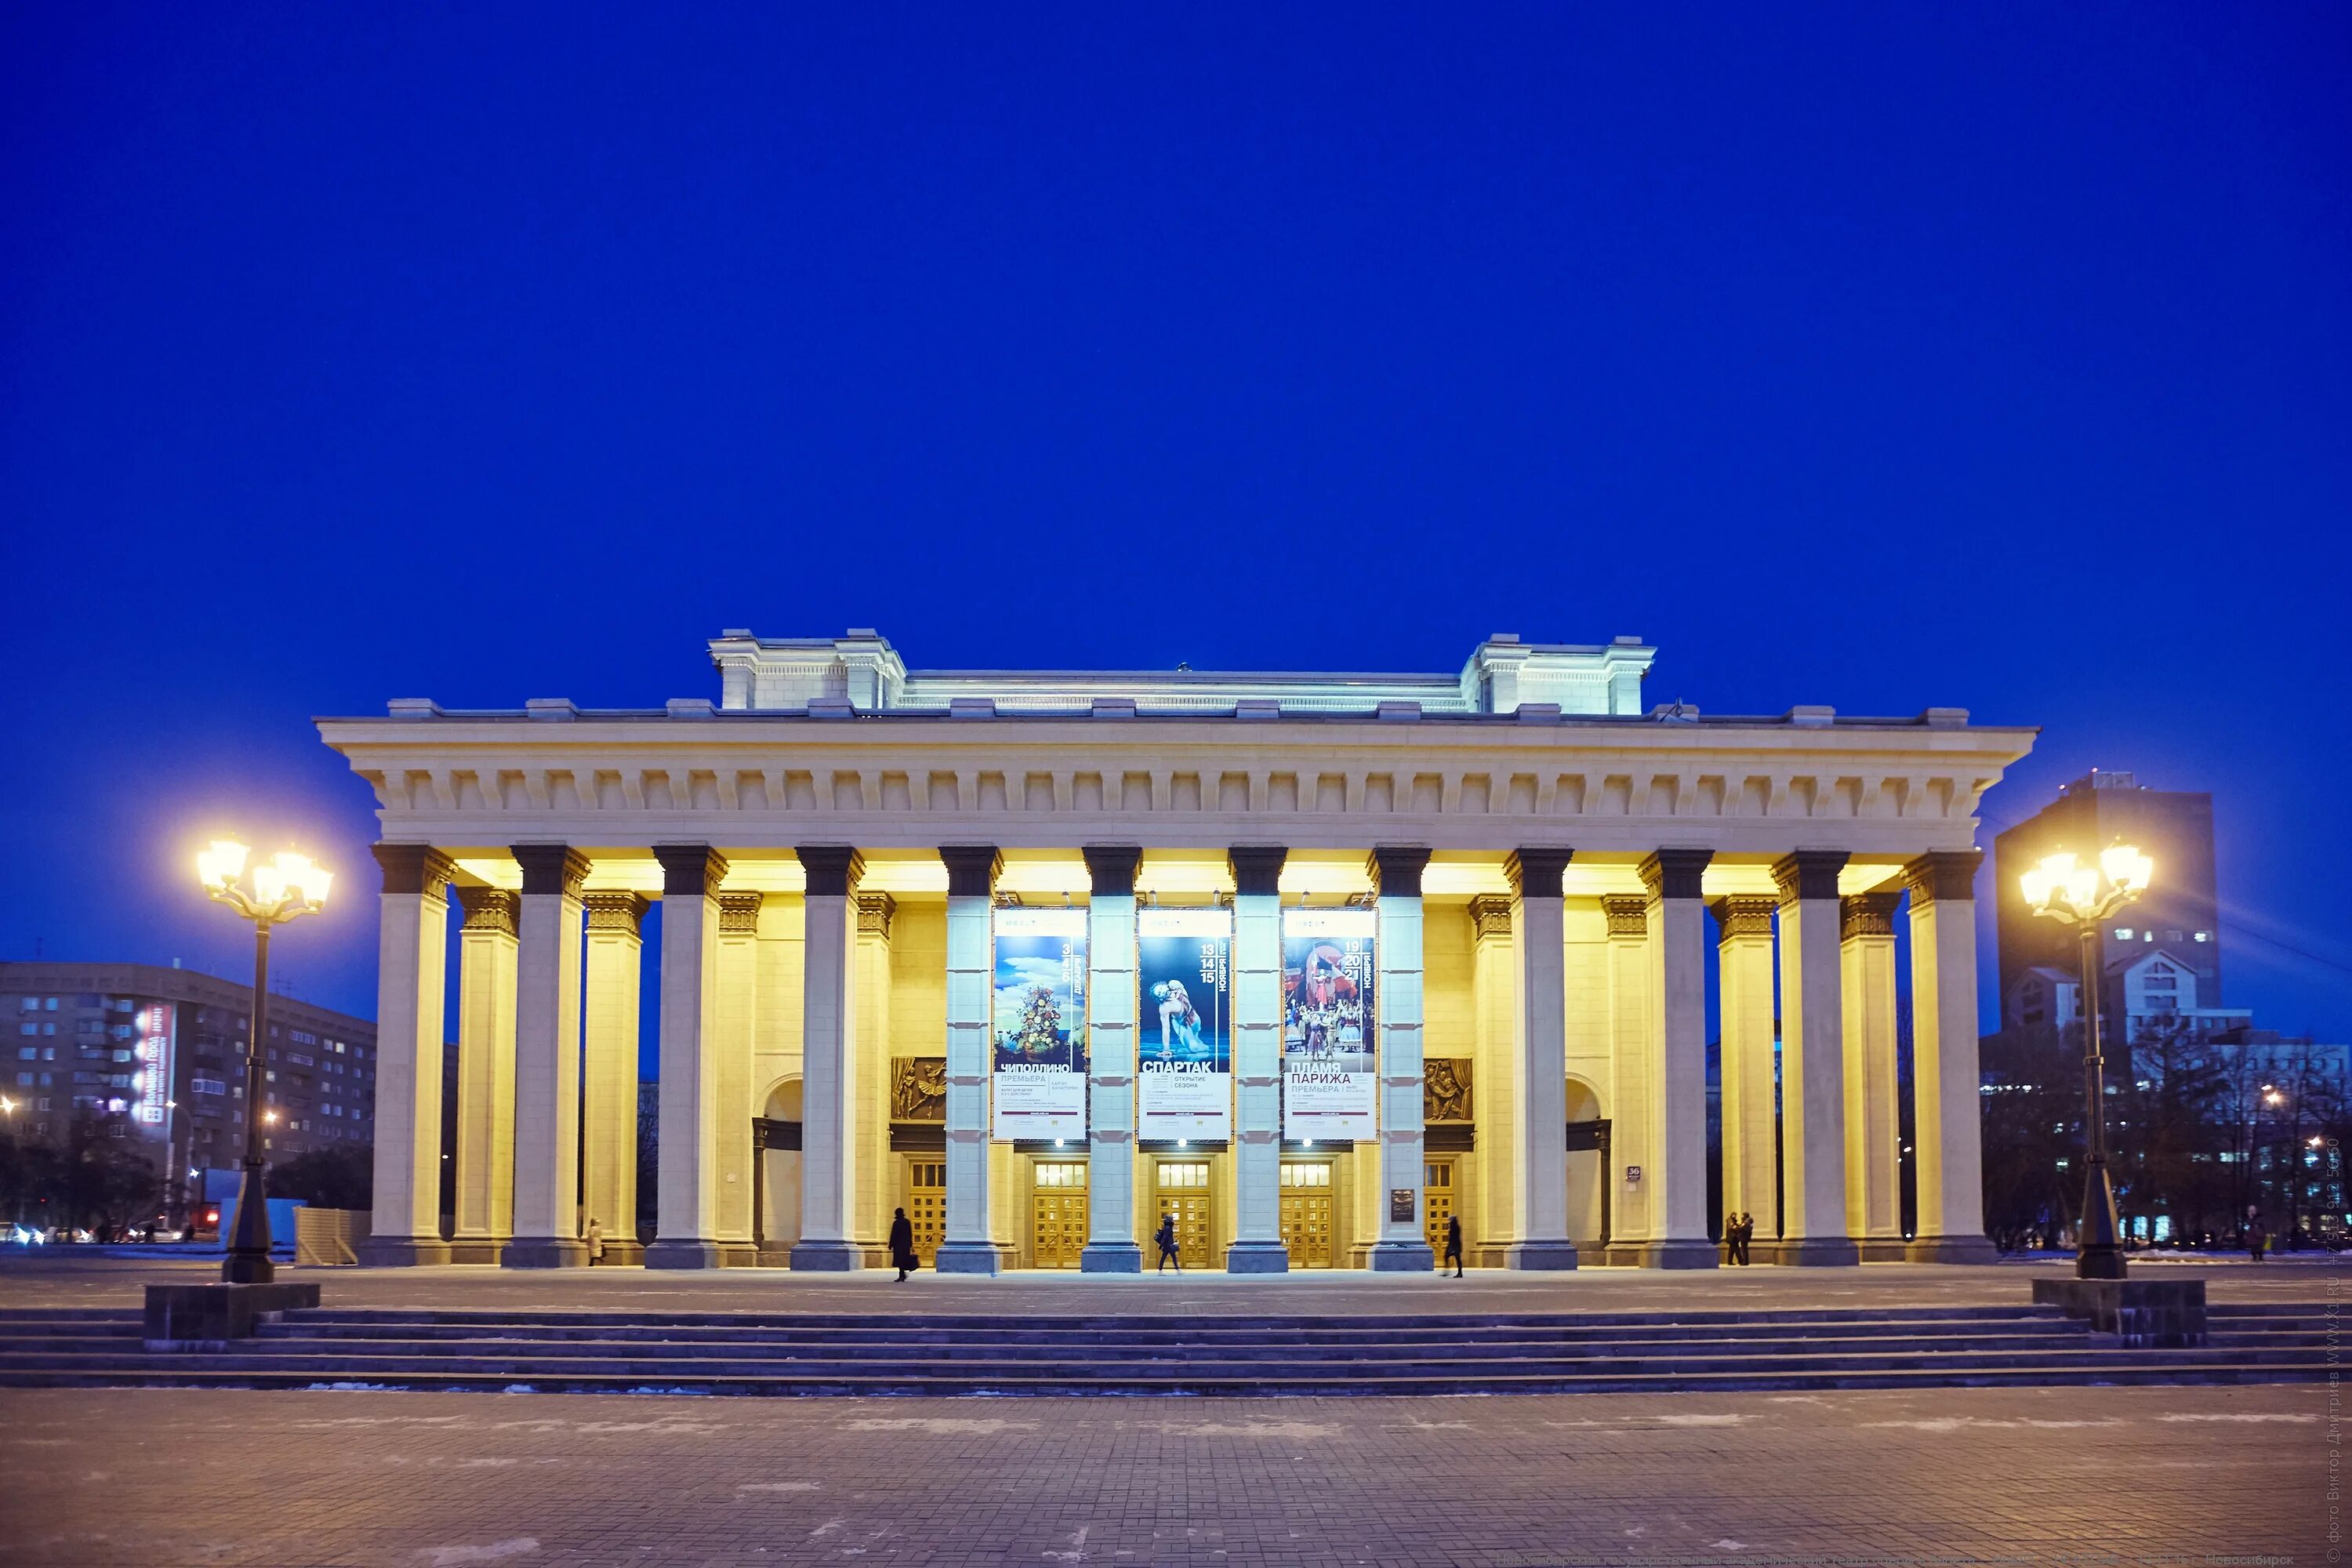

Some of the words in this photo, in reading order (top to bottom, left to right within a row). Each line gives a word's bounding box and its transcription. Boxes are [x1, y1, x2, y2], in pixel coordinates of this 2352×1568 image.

[1062, 944, 1071, 954] 3
[1200, 944, 1214, 956] 13
[1345, 941, 1359, 952] 19
[1062, 957, 1070, 968] 4
[1200, 958, 1214, 969] 14
[1345, 955, 1360, 967] 20
[1062, 971, 1070, 982] 6
[1200, 972, 1214, 983] 15
[1345, 969, 1359, 980] 21
[1000, 1064, 1070, 1073] ЧИПОЛЛИНО
[1142, 1061, 1212, 1073] СПАРТАК
[1291, 1062, 1341, 1073] ПЛАМЯ
[1292, 1073, 1351, 1083] ПАРИЖА
